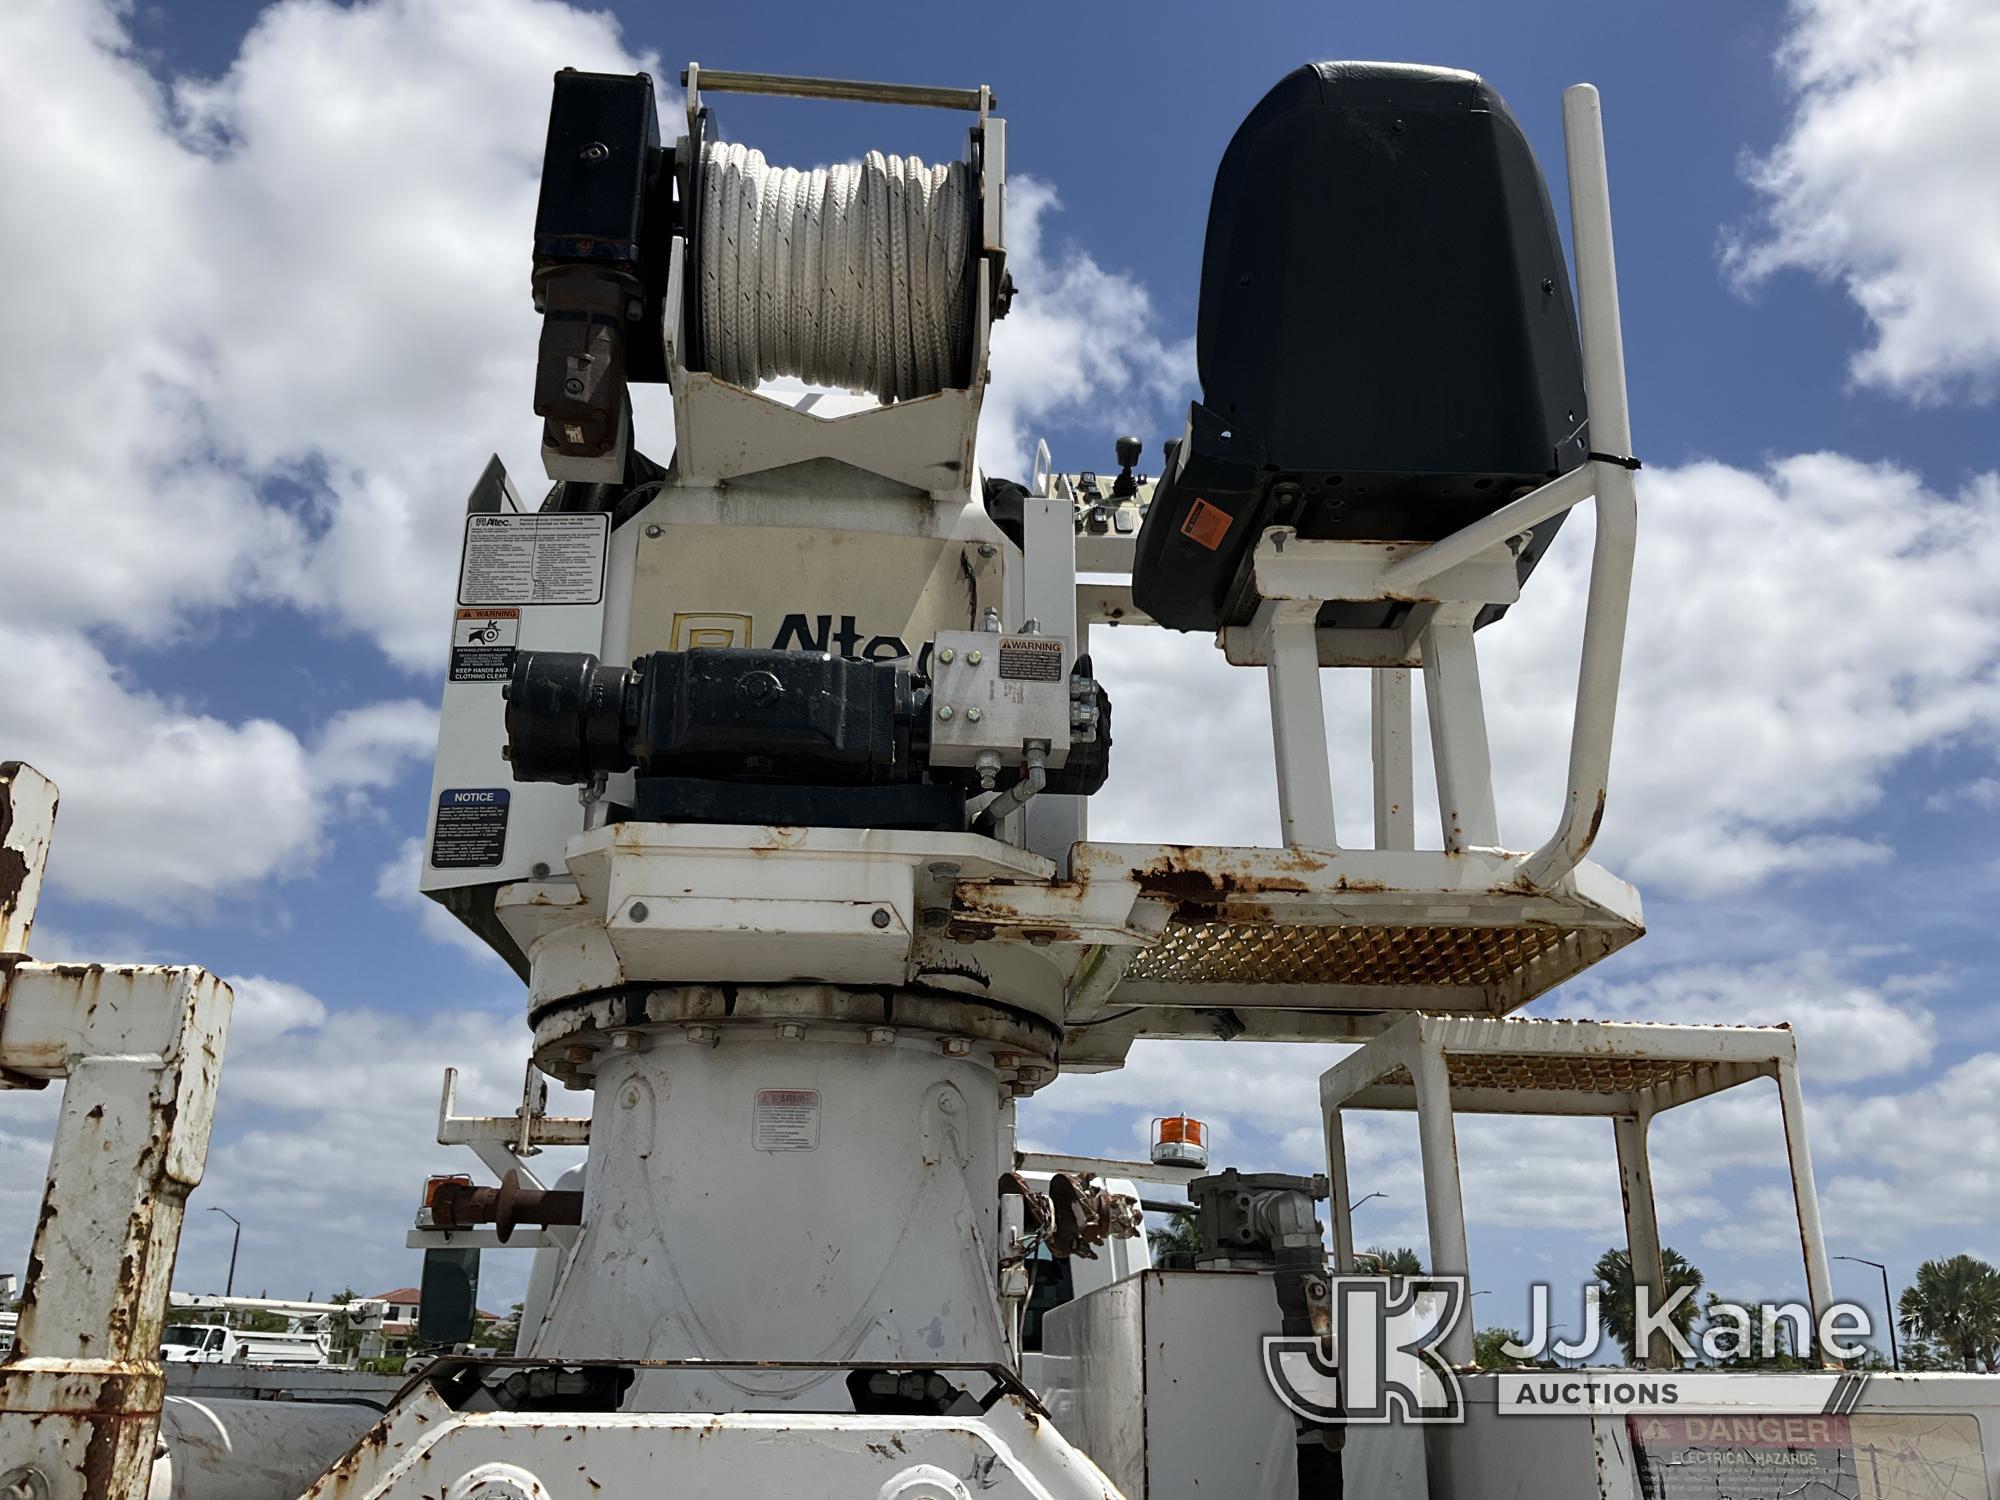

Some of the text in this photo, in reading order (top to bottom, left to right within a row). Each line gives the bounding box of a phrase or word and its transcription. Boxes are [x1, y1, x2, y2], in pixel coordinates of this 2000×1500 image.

[486, 518, 510, 527] Altec
[476, 610, 516, 618] WARNING
[1012, 641, 1061, 651] WARNING
[454, 792, 495, 802] NOTICE
[1684, 1418, 1831, 1442] DANGER
[1672, 1453, 1817, 1465] ELECTRICAL HAZARDS
